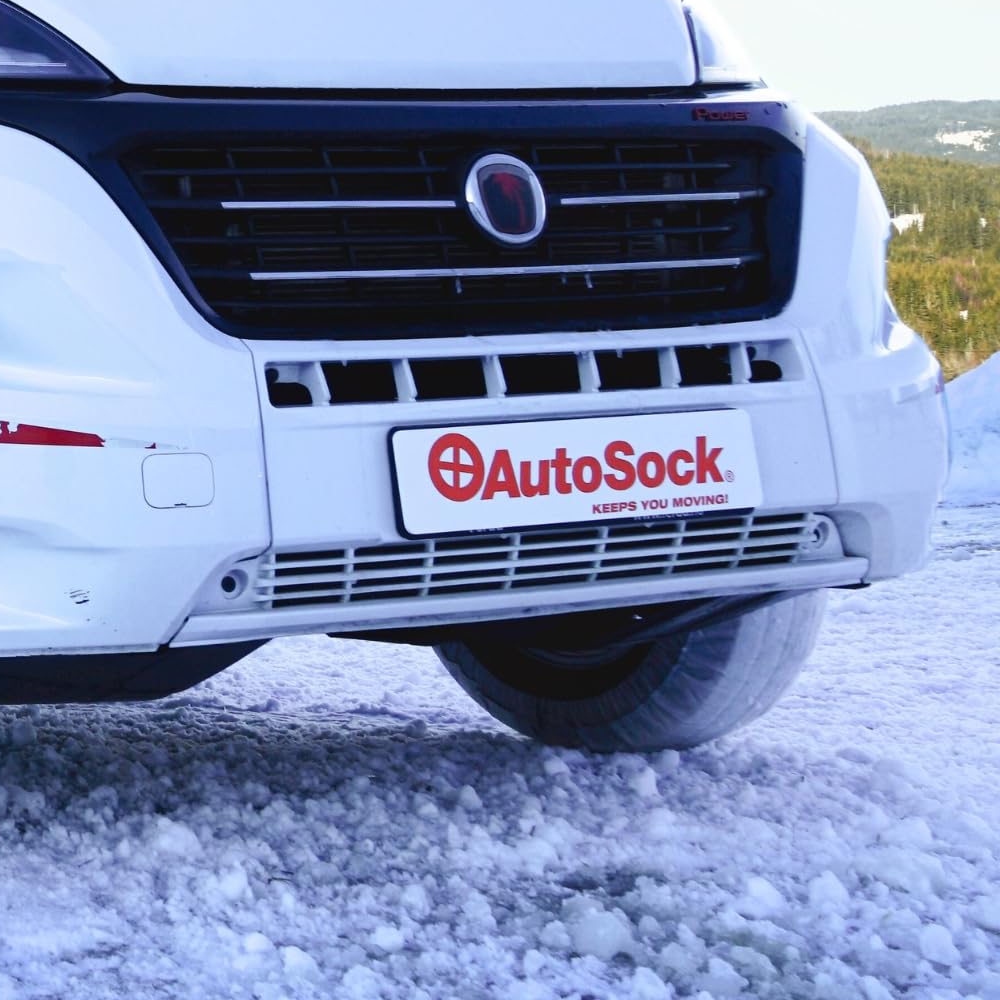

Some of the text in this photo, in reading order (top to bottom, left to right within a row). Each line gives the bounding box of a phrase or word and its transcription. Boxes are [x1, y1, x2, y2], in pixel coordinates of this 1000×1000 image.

[592, 493, 729, 515] KEEPS YOU MOVING!
